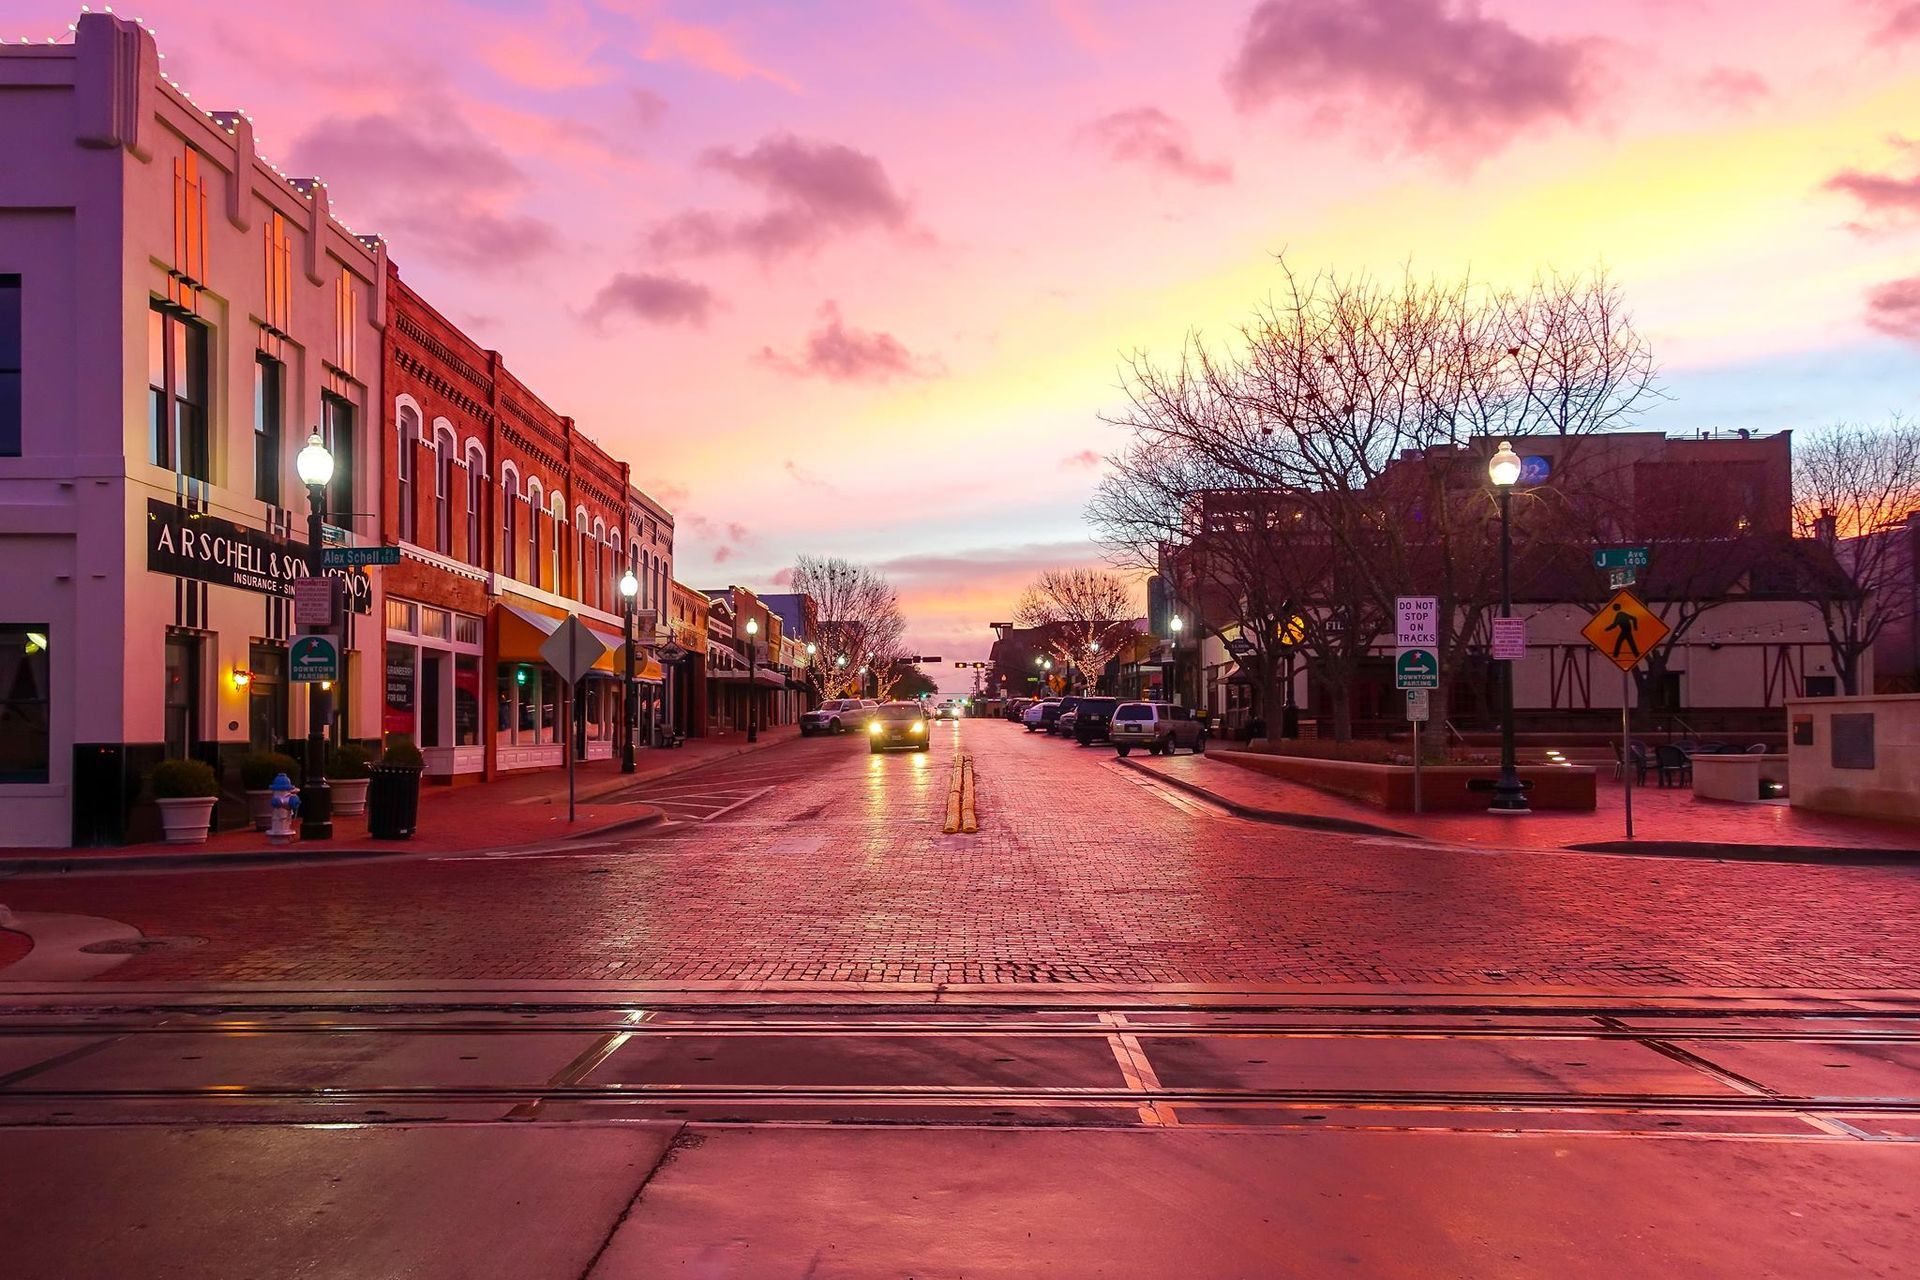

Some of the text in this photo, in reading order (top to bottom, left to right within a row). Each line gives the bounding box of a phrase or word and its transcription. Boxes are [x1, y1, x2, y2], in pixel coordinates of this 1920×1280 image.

[324, 550, 345, 564] Alex
[347, 550, 379, 564] Schell
[1597, 553, 1607, 567] J
[269, 551, 281, 578] &
[233, 572, 277, 593] INSURANCE
[284, 583, 296, 596] SIN
[1399, 601, 1434, 610] DO NOT
[1404, 612, 1429, 621] STOP
[1410, 623, 1424, 631] ON
[1399, 634, 1436, 642] TRACKS
